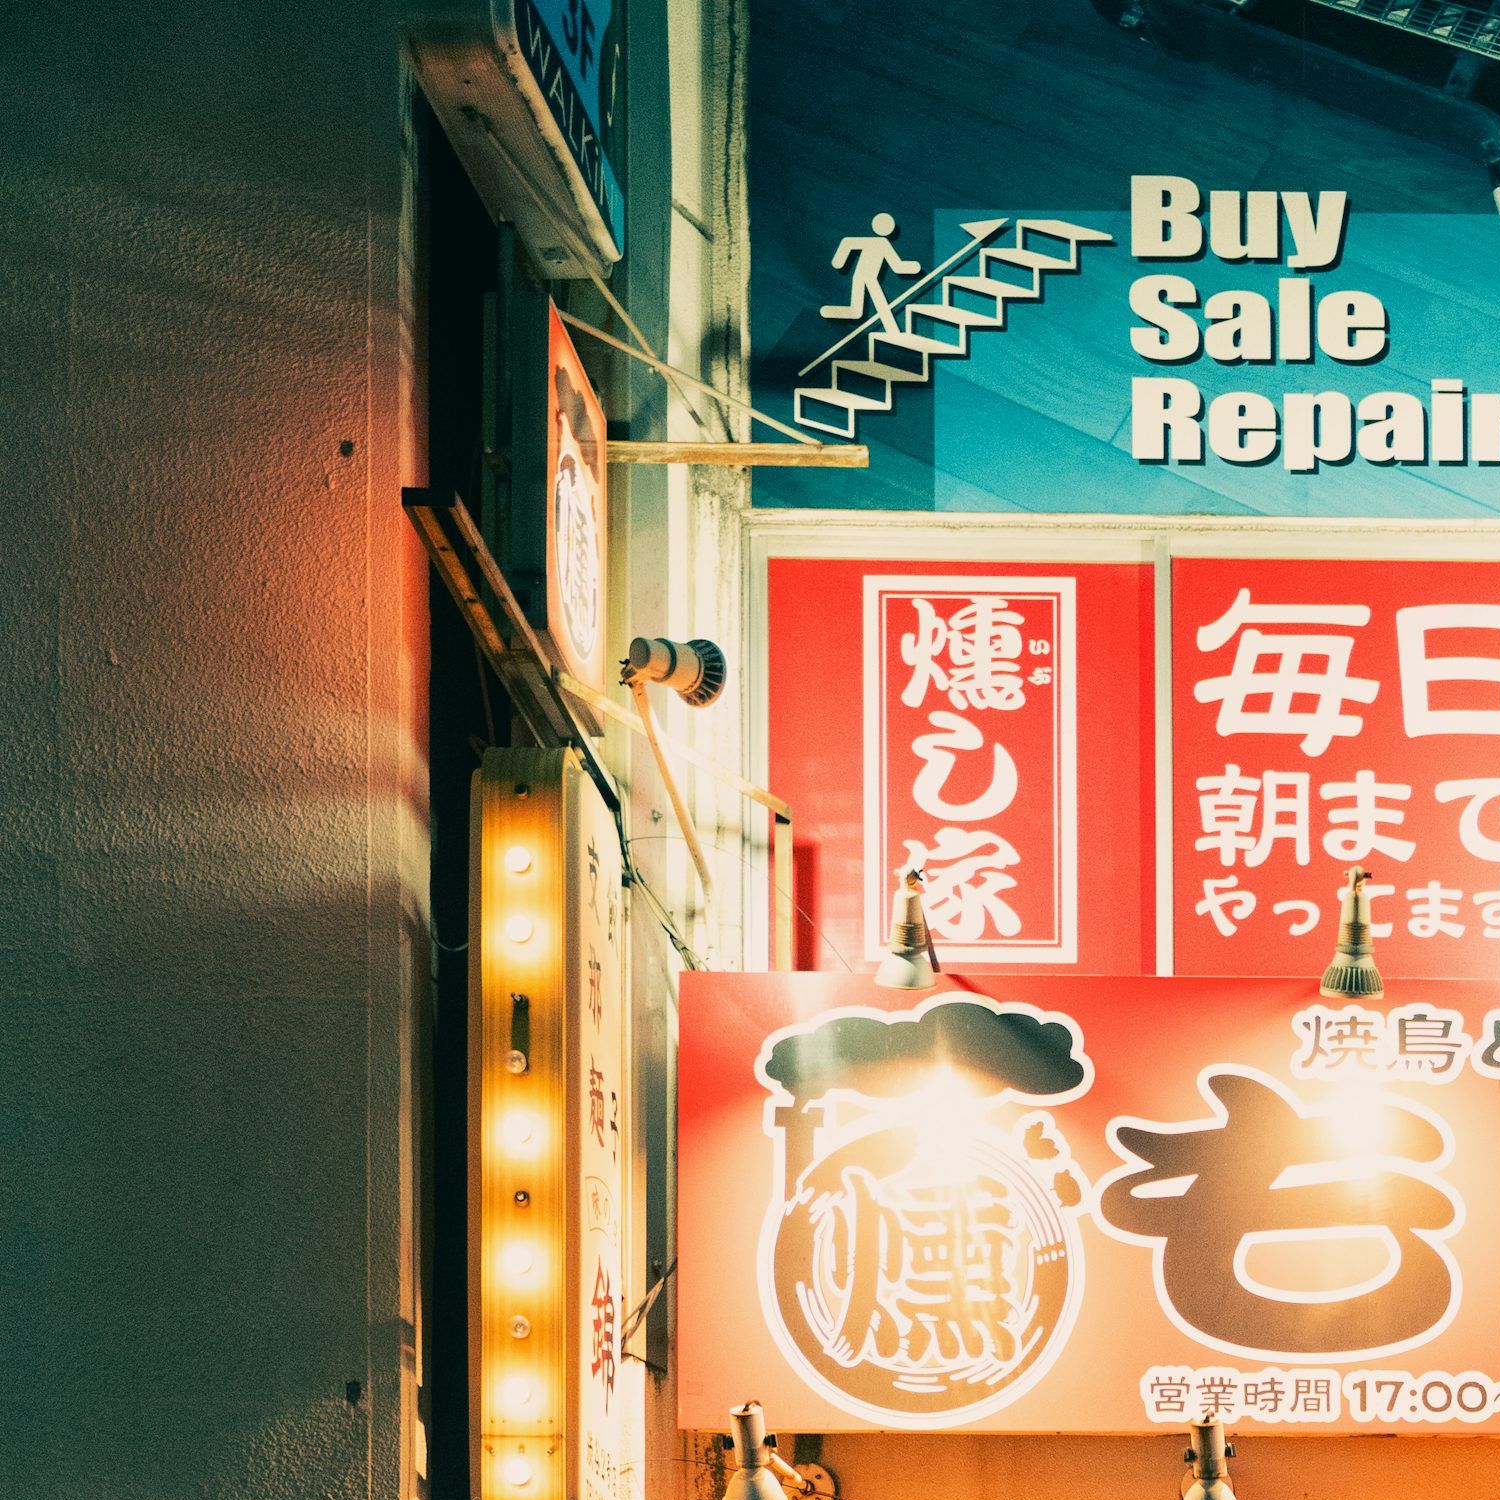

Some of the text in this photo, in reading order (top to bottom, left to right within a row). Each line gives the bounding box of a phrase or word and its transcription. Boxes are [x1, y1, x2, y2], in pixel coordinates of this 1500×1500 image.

[1130, 175, 1347, 268] Buy
[1129, 274, 1389, 362] Sale
[1149, 1376, 1332, 1416] 営業時間
